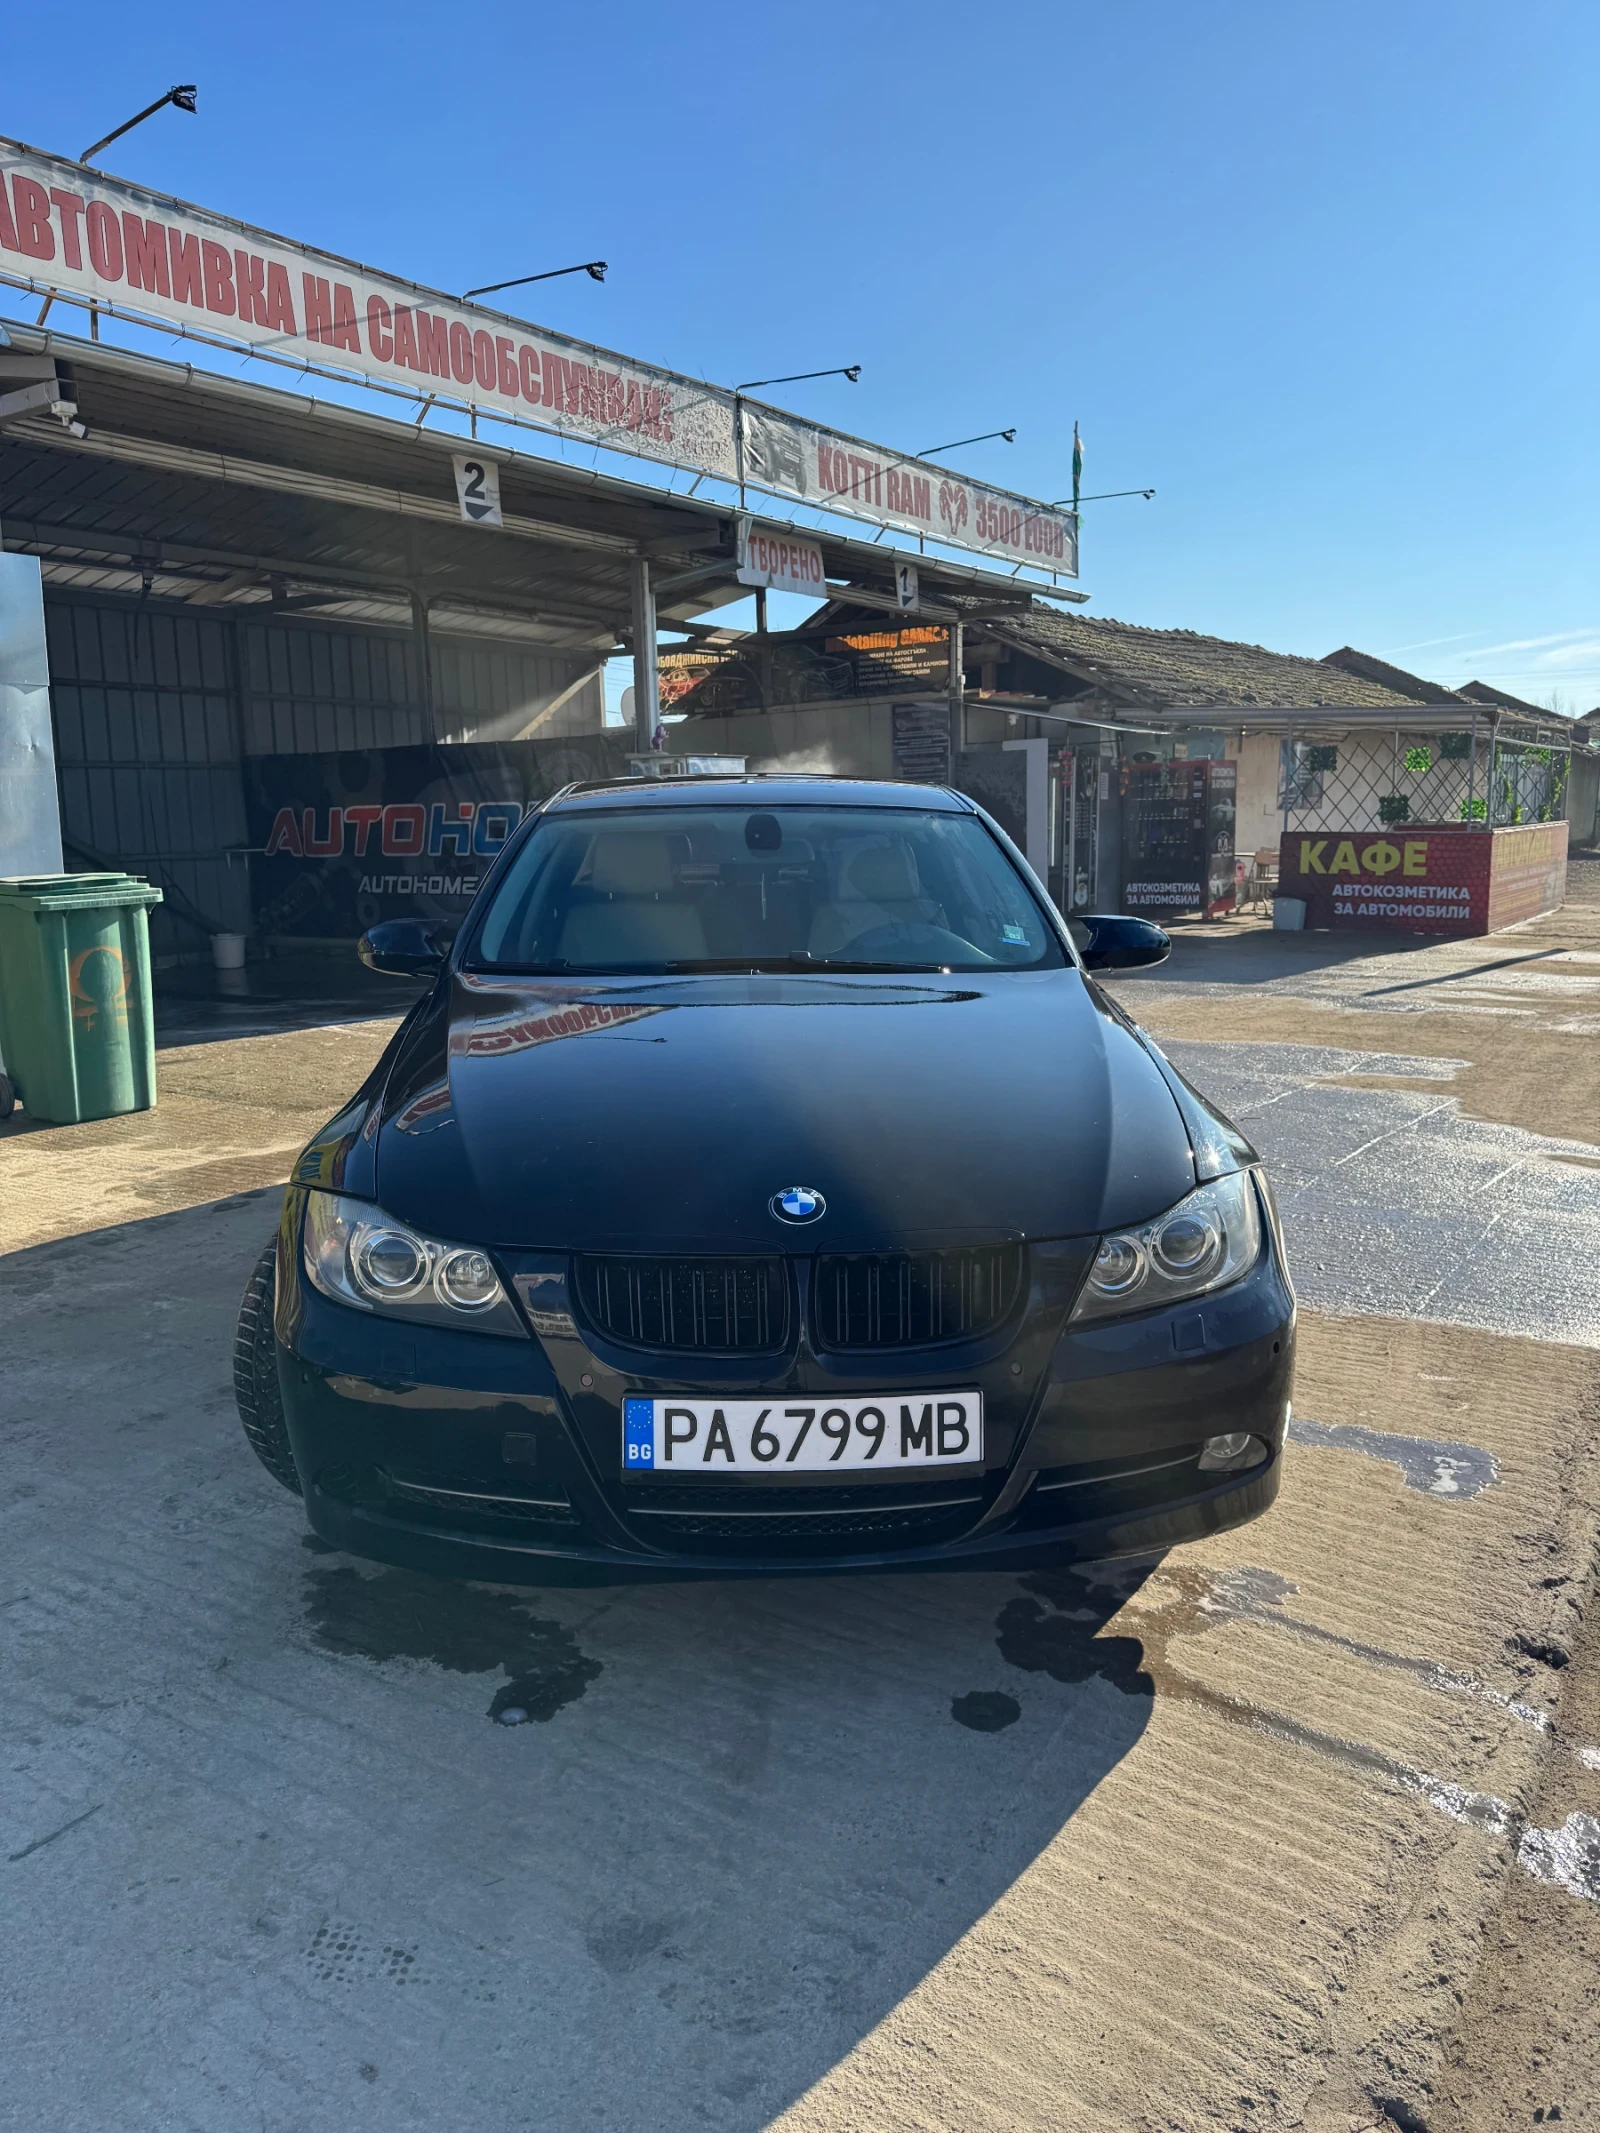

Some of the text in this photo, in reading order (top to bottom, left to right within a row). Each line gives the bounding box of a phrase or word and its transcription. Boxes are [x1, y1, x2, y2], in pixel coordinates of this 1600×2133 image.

[302, 272, 361, 355] НА
[463, 461, 486, 500] 2
[817, 443, 883, 507] KOTTI
[886, 467, 931, 522] RAM
[976, 498, 1021, 547] 3500
[748, 535, 821, 584] ТВОРЕНО
[899, 567, 908, 592] 1
[265, 802, 541, 857] AUTOHO
[1299, 840, 1428, 876] КАФЕ
[357, 875, 479, 895] AUTOHOME
[1126, 882, 1200, 893] АВТОКОЗМЕТИКА
[1332, 883, 1471, 900] АВТОКОЗМЕТИКА
[1126, 894, 1200, 905] ЗА АВТОМОБИЛИ
[1334, 902, 1470, 919] ЗА АВТОМОБИЛИ
[777, 1187, 820, 1198] BMW
[664, 1402, 970, 1463] PA 6799 MB
[628, 1443, 652, 1460] BG
